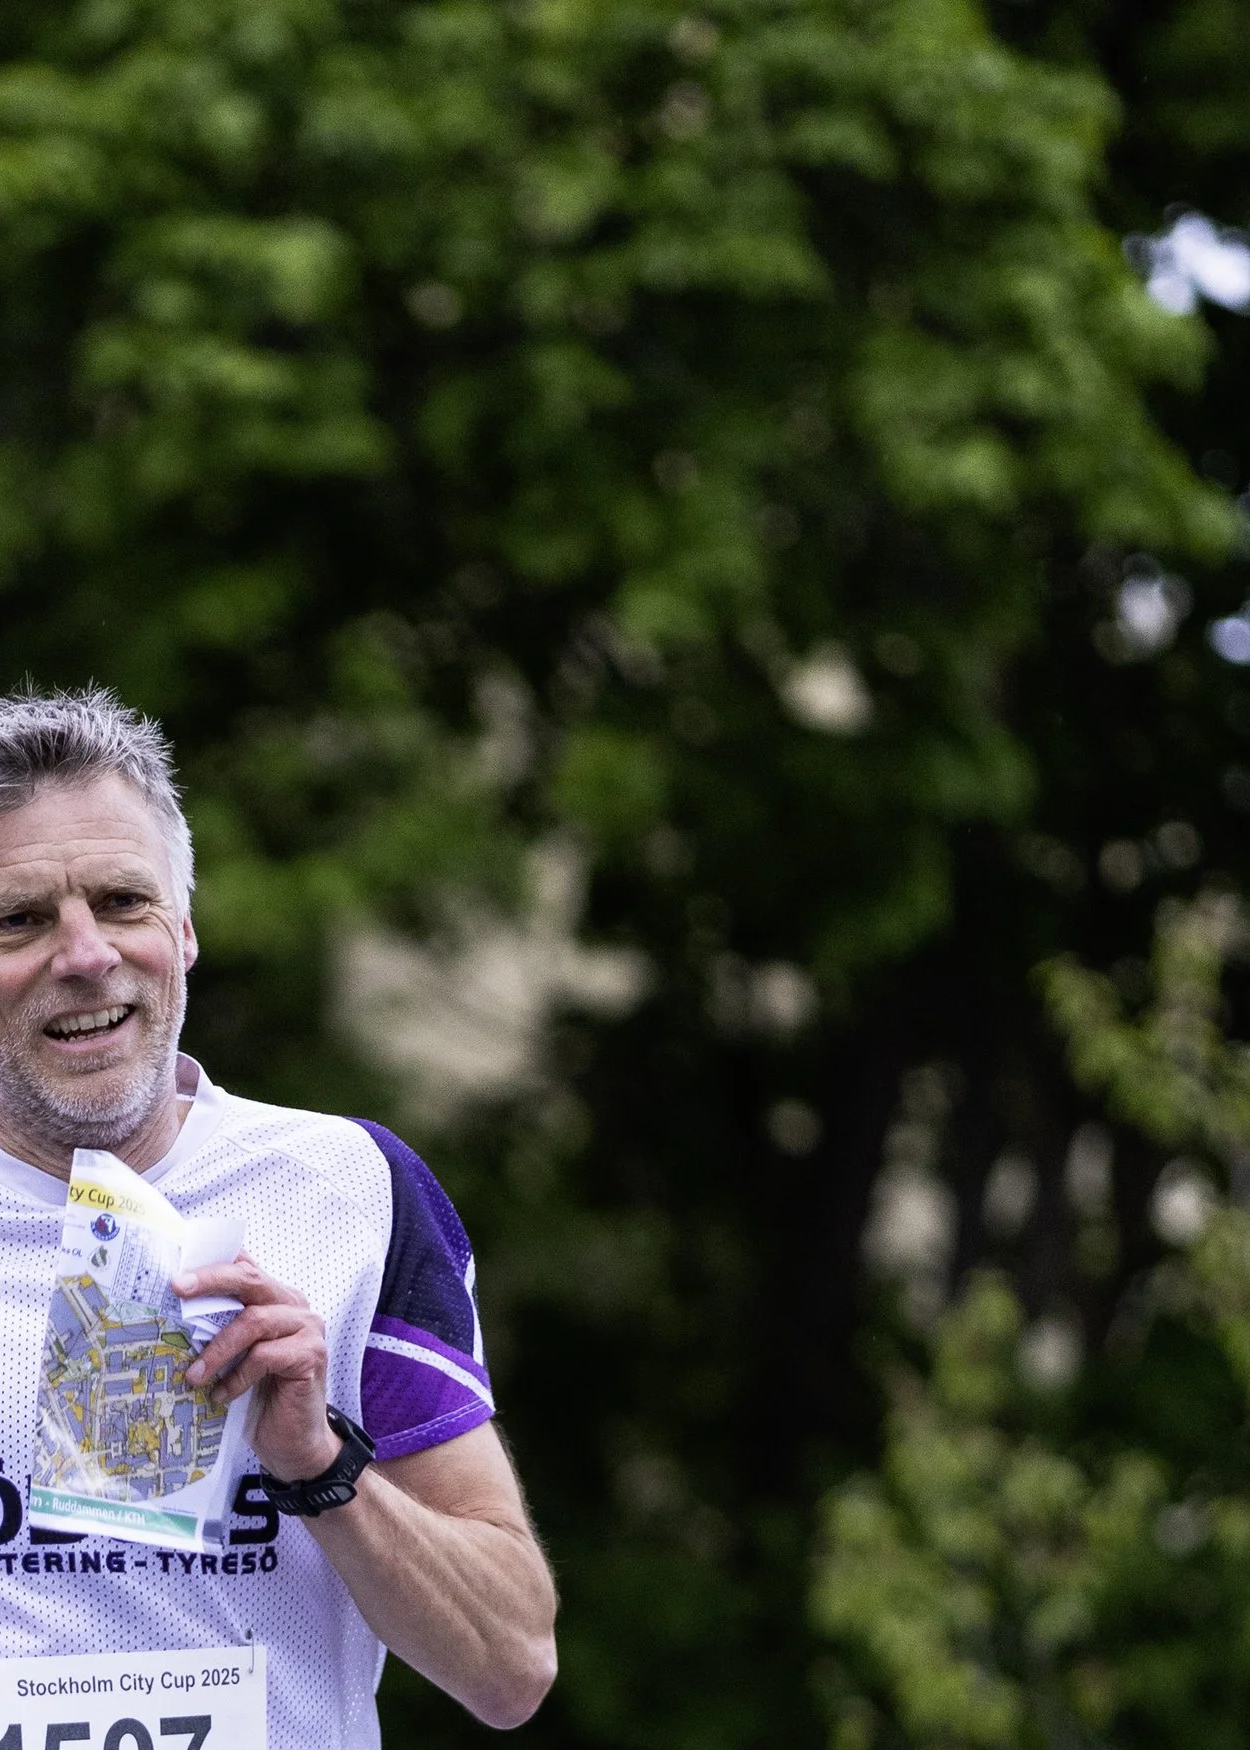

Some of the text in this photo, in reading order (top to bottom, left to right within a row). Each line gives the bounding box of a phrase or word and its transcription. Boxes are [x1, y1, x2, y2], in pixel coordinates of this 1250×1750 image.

[88, 1188, 116, 1209] Cup
[117, 1195, 146, 1215] 2025
[52, 1496, 116, 1521] Ruddammen
[124, 1510, 147, 1527] KTH
[16, 1667, 241, 1697] Stockholm City Cup 2025
